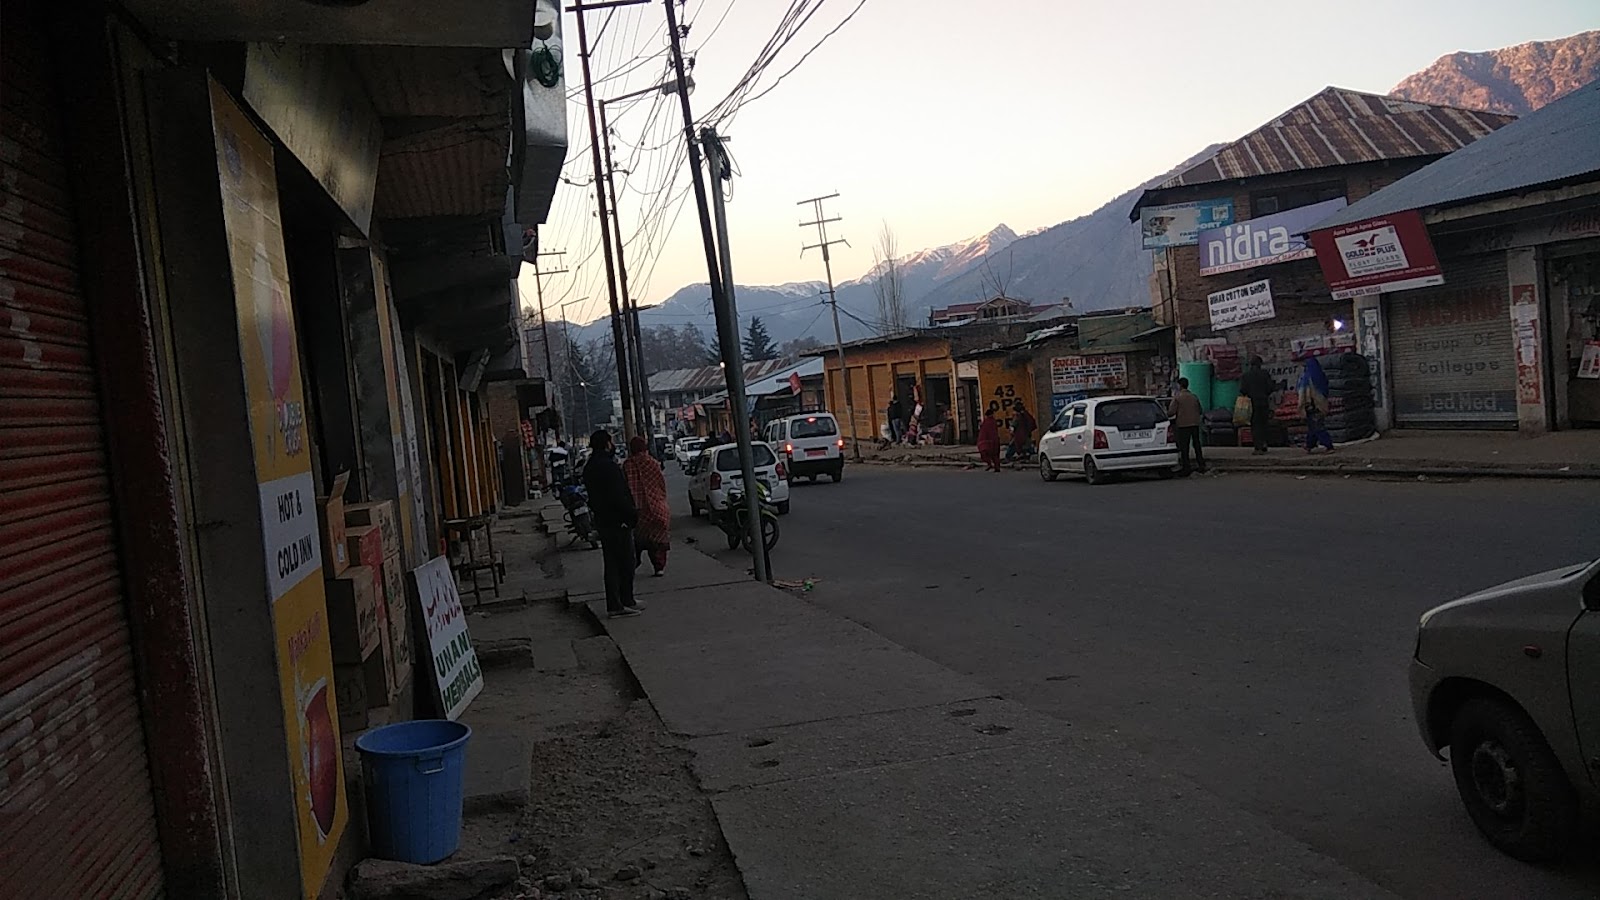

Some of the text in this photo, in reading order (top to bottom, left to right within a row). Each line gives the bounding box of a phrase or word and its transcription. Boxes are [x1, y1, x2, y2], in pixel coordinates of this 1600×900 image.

[1208, 224, 1290, 267] nidra
[1345, 245, 1397, 259] GOLD PLUS
[1226, 288, 1248, 301] COTTON
[1414, 338, 1459, 352] Group
[1418, 360, 1500, 376] Colleges
[994, 384, 1015, 397] 43
[277, 489, 302, 523] HOT &
[277, 534, 313, 579] COLD INN
[435, 629, 472, 678] UNANI
[442, 655, 481, 714] HERBALS
